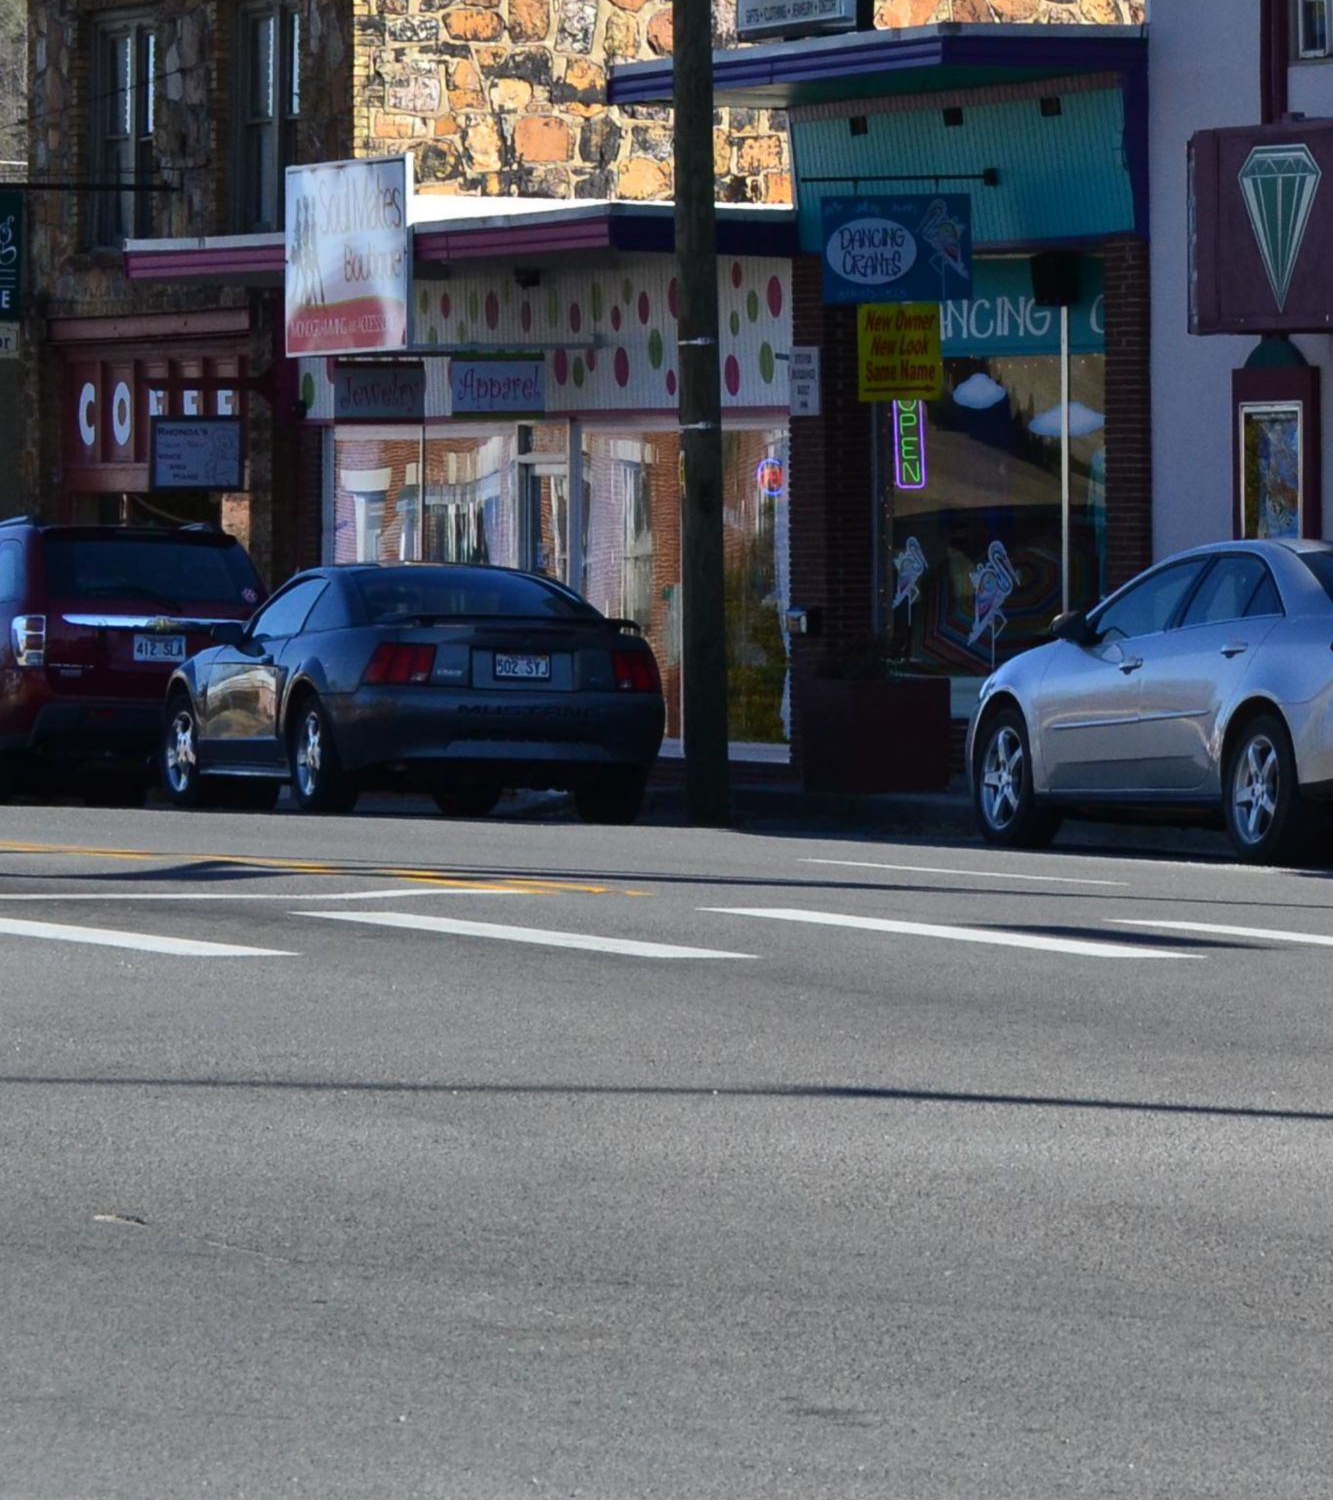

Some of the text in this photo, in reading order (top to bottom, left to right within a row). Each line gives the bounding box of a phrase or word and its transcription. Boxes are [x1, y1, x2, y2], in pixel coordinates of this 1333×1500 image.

[840, 227, 905, 250] DANCING
[842, 250, 902, 278] CRANES
[864, 308, 936, 332] New Owner
[870, 335, 929, 357] New Look
[866, 357, 937, 382] Same Name
[457, 364, 542, 409] Apparel
[135, 641, 184, 657] 412 SLA
[497, 659, 520, 675] 502
